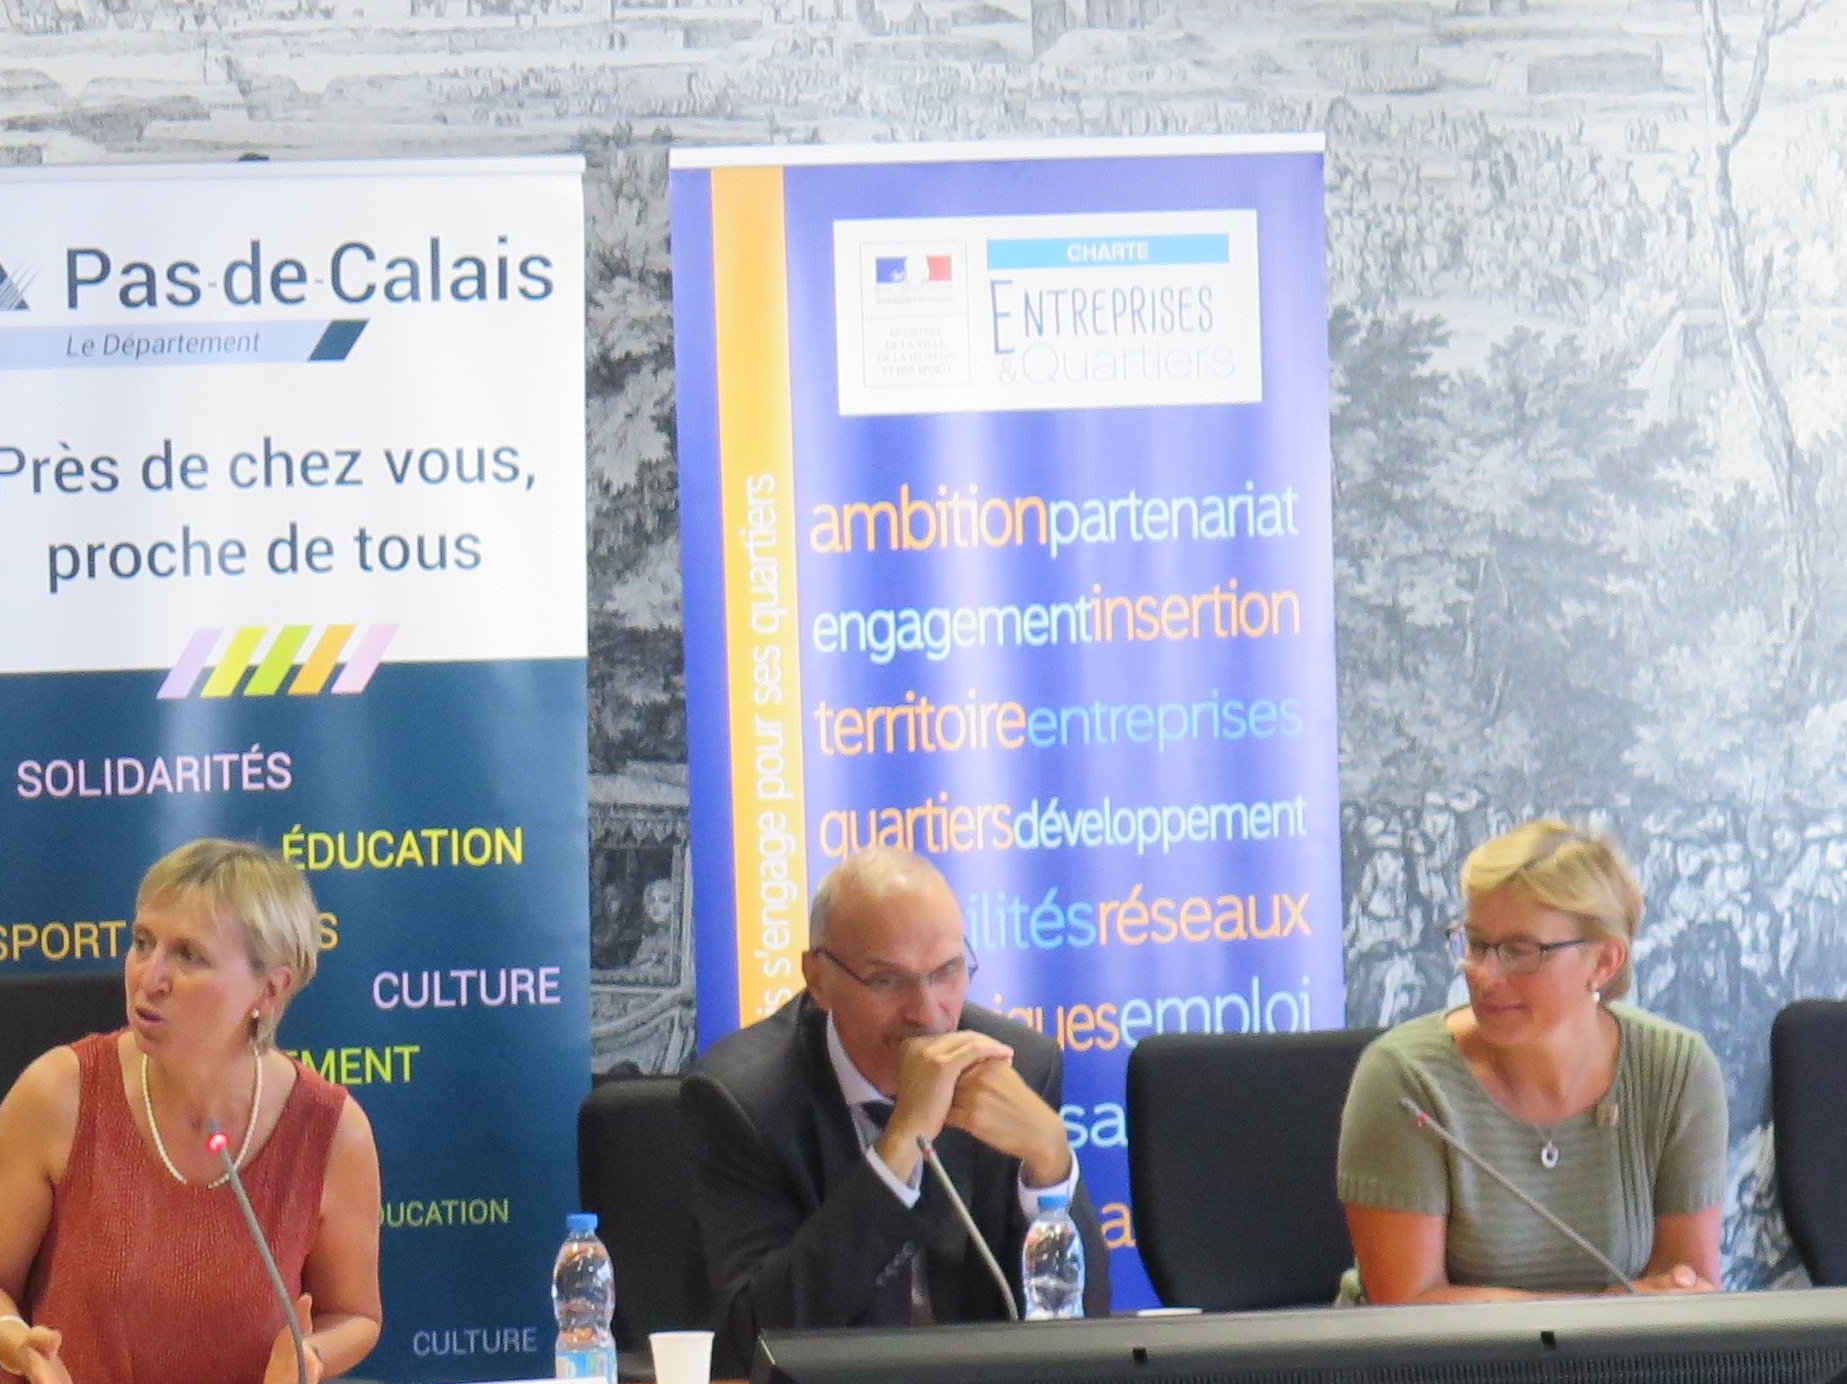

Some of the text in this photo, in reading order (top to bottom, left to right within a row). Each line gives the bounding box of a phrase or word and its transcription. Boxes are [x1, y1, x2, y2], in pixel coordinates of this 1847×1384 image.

[66, 236, 555, 309] Pas-de-Calais
[1067, 241, 1149, 263] CHARTE
[66, 330, 261, 361] Le Département
[141, 438, 209, 491] de
[229, 435, 364, 488] chez
[383, 443, 537, 492] vous,
[48, 521, 483, 595] proche de tous
[738, 473, 790, 635] quartiers
[752, 643, 783, 705] ses
[16, 742, 293, 799] SOLIDARITÉS
[754, 714, 794, 801] pour
[282, 824, 524, 872] ÉDUCATION
[753, 810, 798, 977] s'engage
[371, 966, 561, 1011] CULTURE
[412, 1325, 537, 1357] CULTURE
